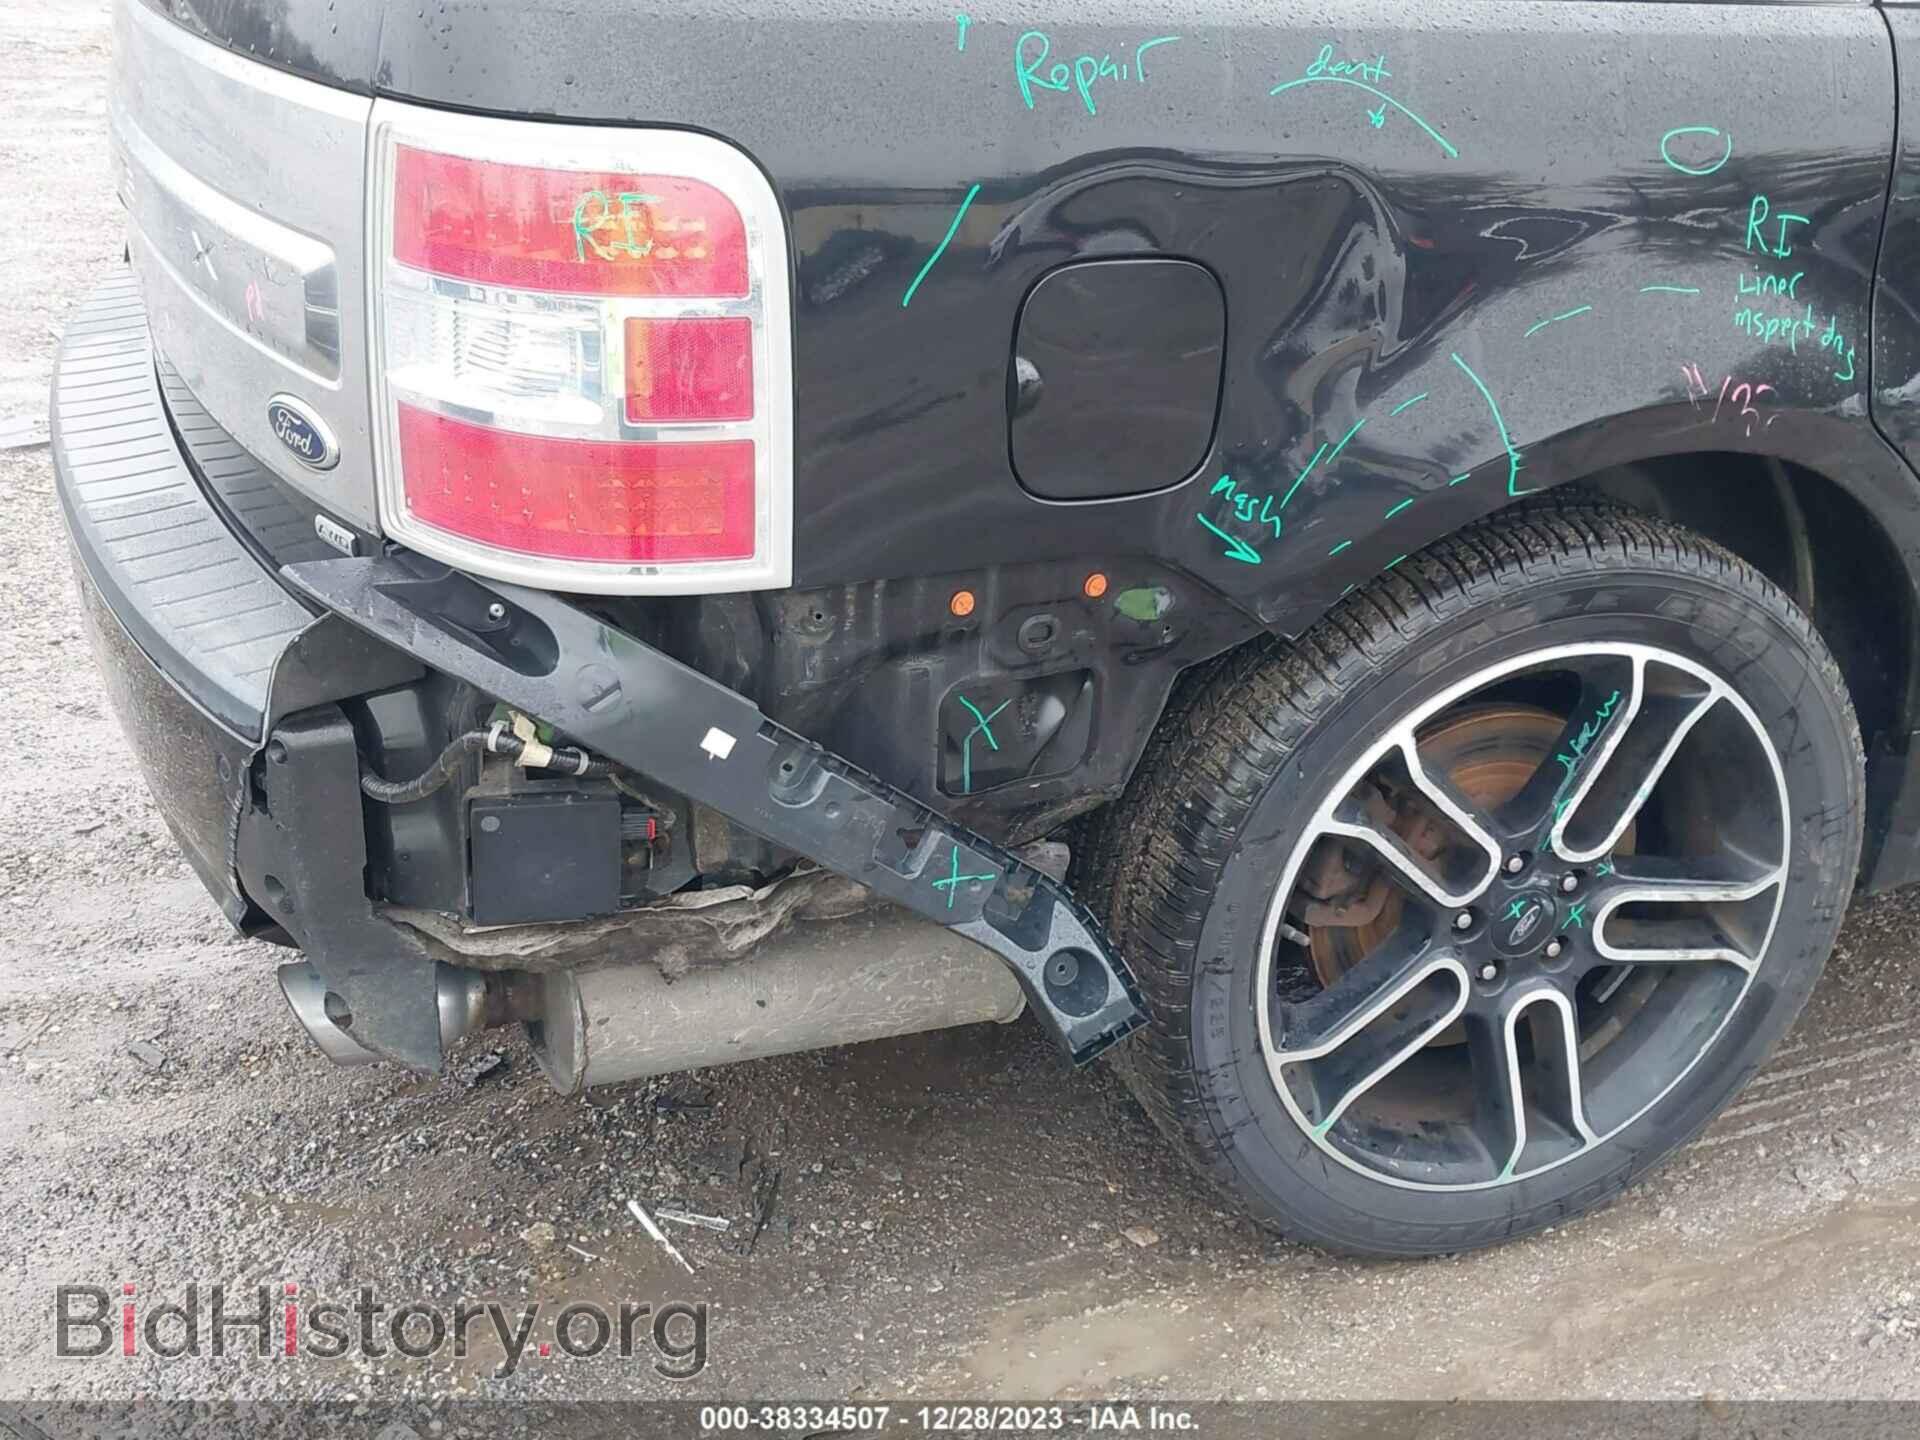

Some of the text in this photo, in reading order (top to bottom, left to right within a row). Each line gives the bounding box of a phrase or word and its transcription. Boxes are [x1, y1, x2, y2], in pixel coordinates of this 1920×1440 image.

[1016, 31, 1183, 115] Repair
[1739, 265, 1804, 299] Liner
[273, 408, 313, 458] Ford
